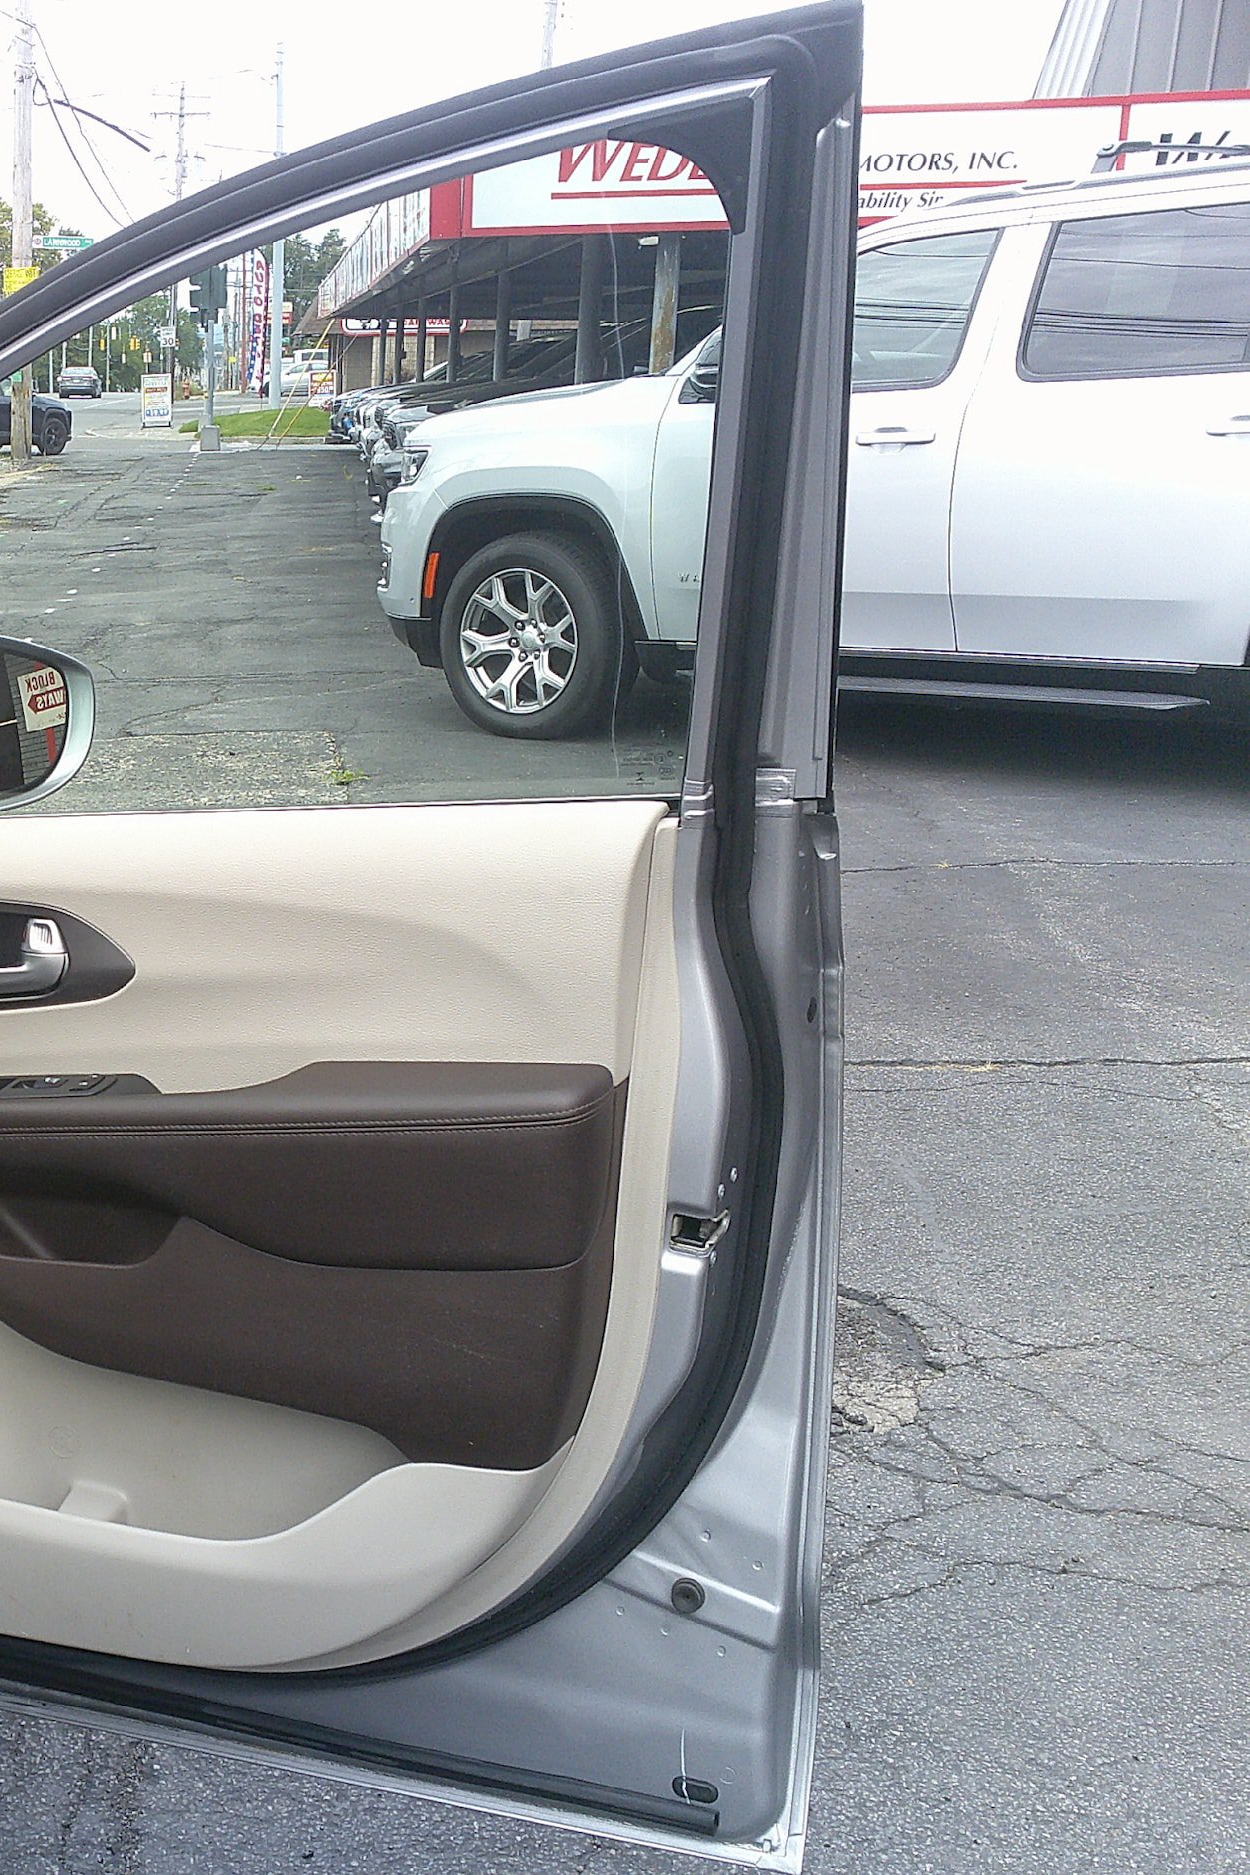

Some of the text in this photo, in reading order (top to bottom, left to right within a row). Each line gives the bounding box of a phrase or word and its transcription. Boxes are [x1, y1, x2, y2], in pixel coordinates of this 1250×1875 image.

[558, 138, 708, 183] WED
[968, 151, 1018, 170] INC.
[254, 260, 265, 307] AUTO
[162, 337, 174, 346] 30
